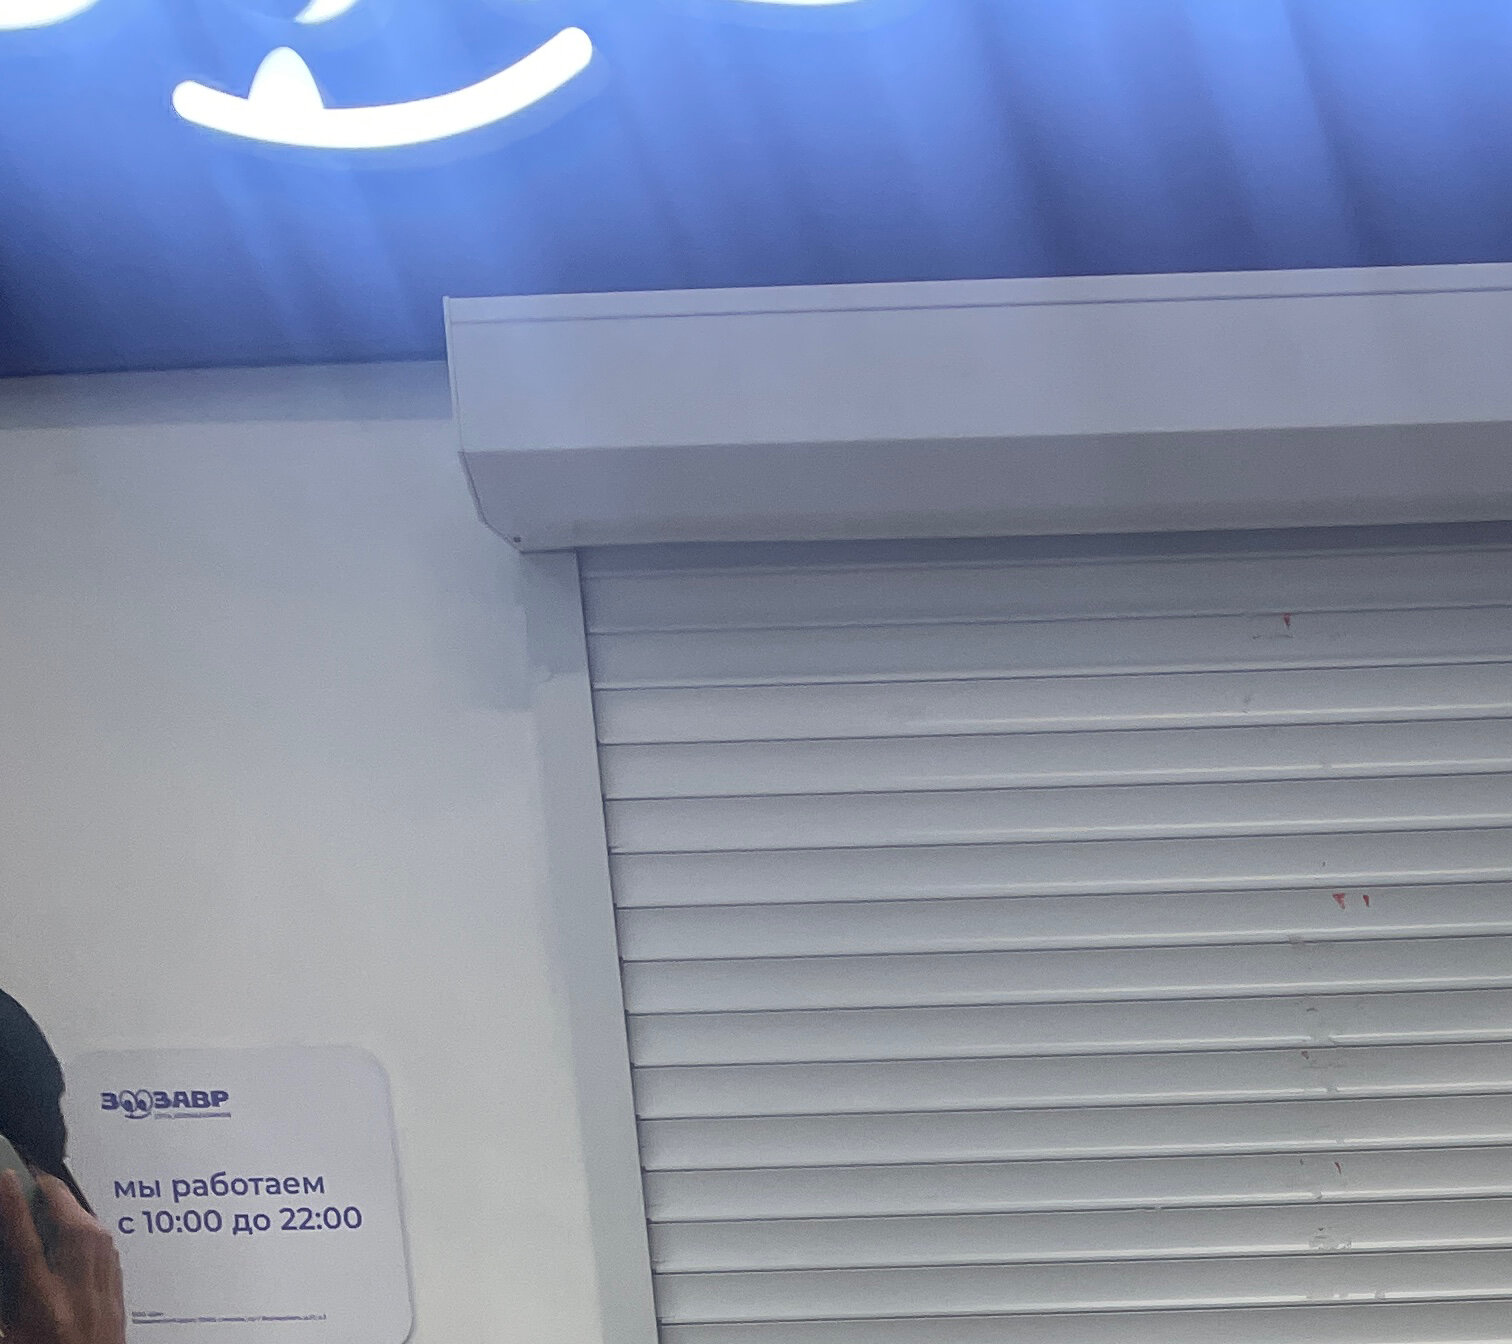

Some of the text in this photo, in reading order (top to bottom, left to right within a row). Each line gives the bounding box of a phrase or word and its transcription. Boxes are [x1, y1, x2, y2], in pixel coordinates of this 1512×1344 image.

[101, 1089, 229, 1113] ЗООЗАВР
[114, 1171, 325, 1203] мы работаем
[117, 1206, 362, 1235] с 10:00 до 22:00
